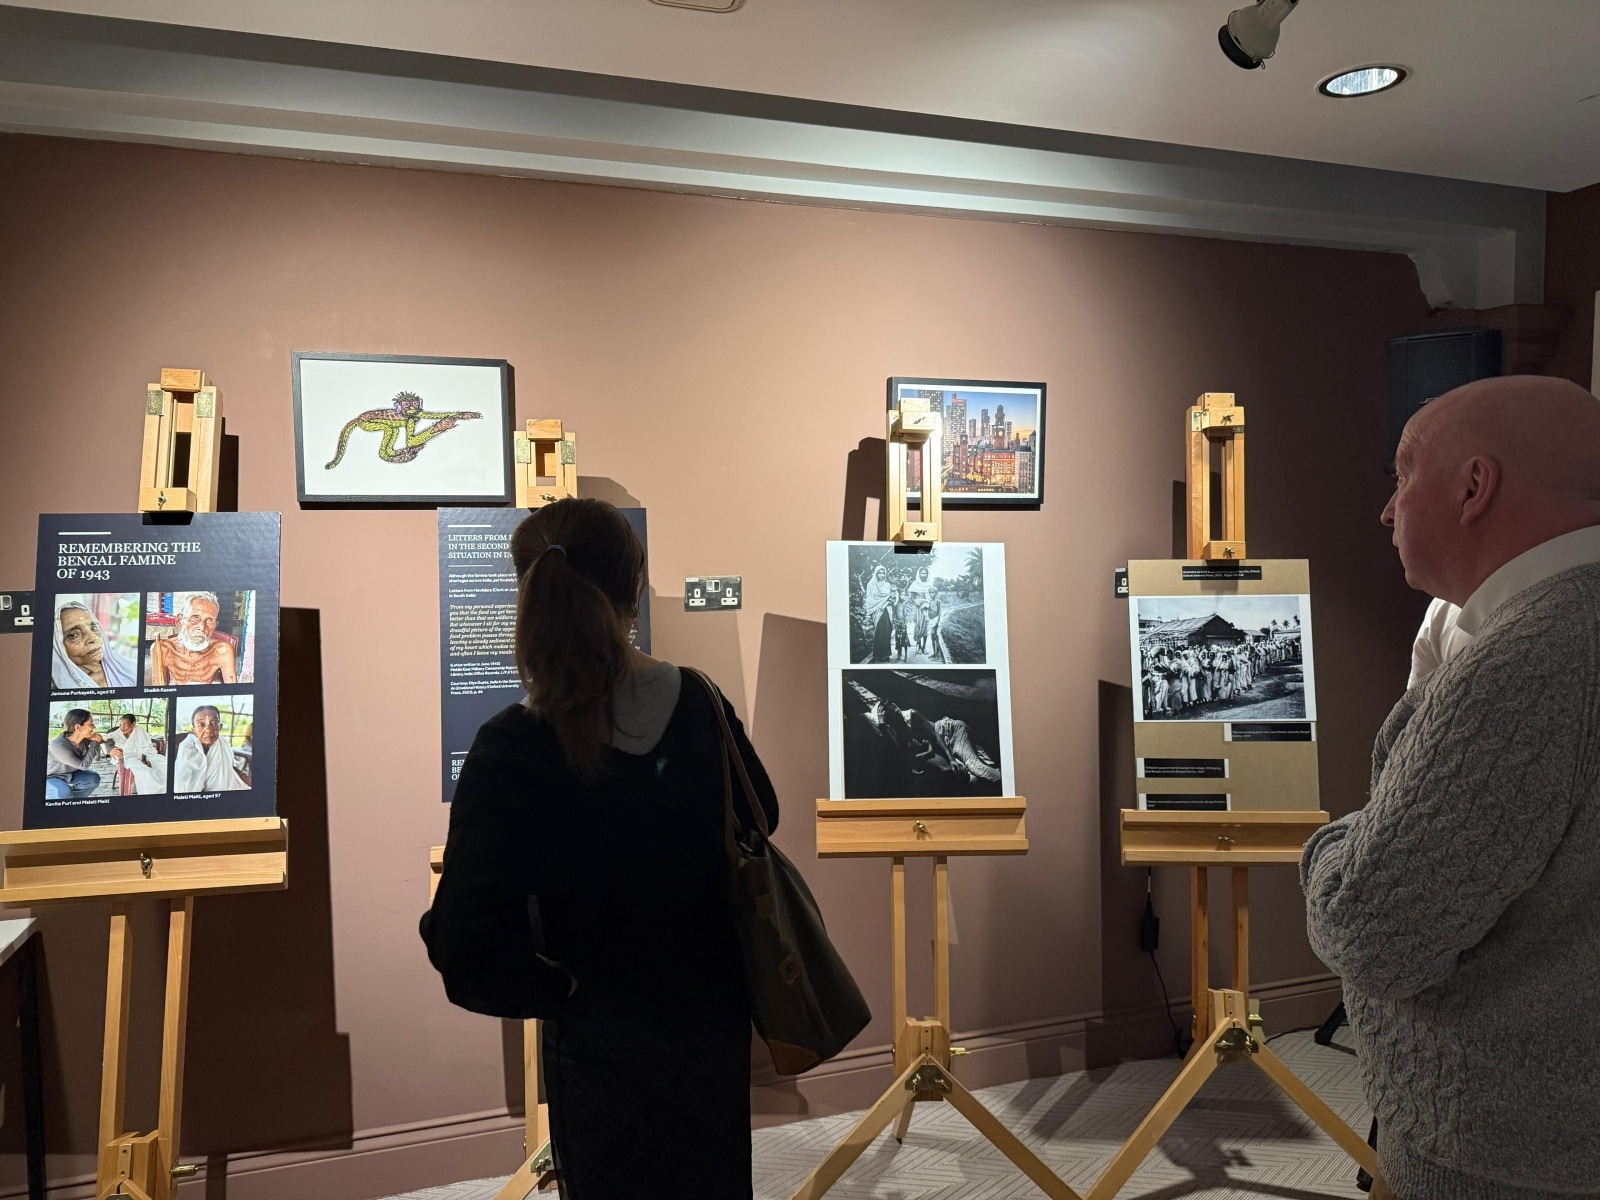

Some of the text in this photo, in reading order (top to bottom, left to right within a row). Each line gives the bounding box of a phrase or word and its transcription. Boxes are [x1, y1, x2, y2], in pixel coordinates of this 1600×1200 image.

[58, 542, 201, 554] REMEMBERING THE
[57, 554, 176, 566] BENGAL FAMINE
[56, 568, 110, 581] OF 1943
